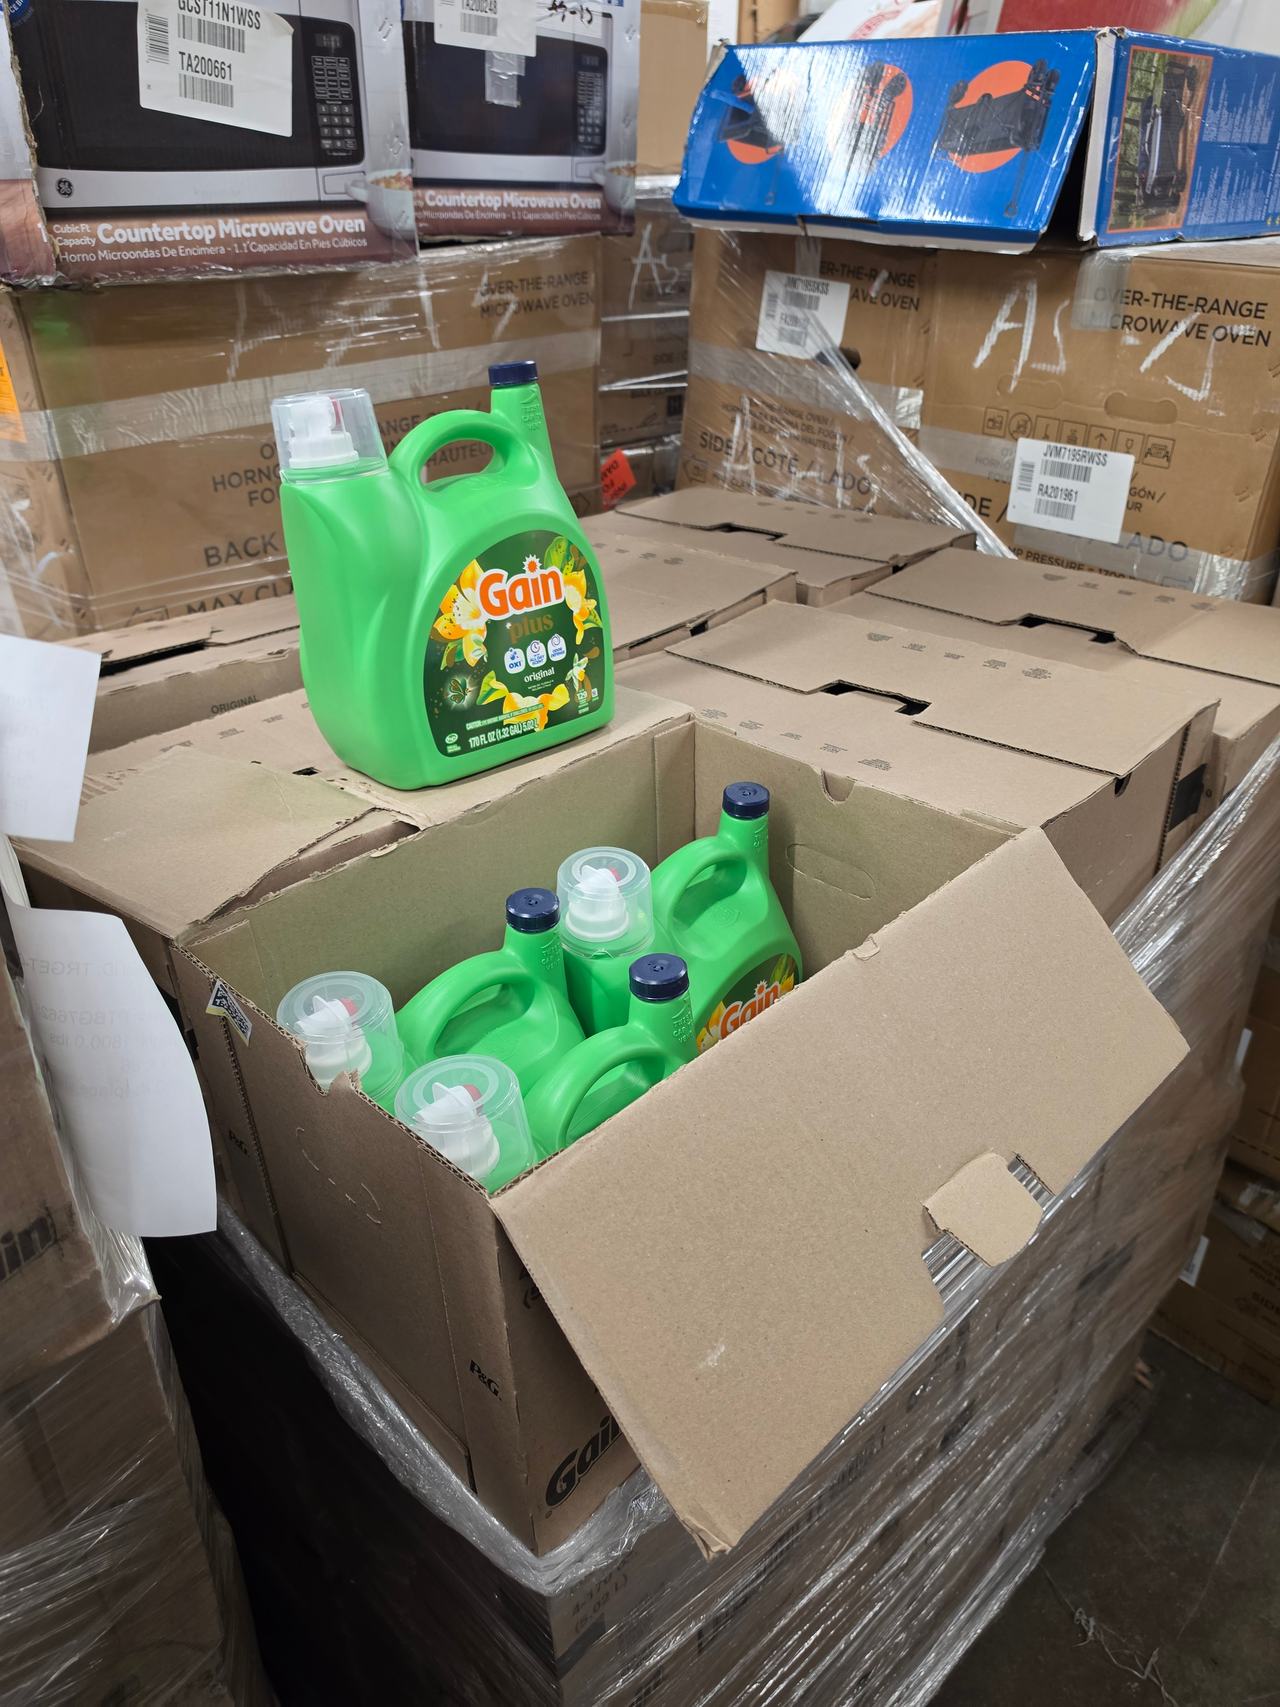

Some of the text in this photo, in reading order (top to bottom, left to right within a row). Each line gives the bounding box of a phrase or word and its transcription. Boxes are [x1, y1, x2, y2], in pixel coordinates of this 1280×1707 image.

[178, 0, 261, 30] GCST11N1WSS
[178, 51, 233, 81] TA200661
[426, 190, 601, 211] Countertop Microwave Oven
[56, 236, 96, 248] Capacity
[96, 214, 366, 245] Countertop Microwave Oven
[59, 251, 97, 263] Horno
[98, 247, 161, 261] Microondas
[162, 246, 178, 257] De
[179, 244, 226, 257] Encimera
[250, 239, 299, 254] Capacidad
[300, 239, 312, 250] En
[312, 238, 331, 249] Pies
[880, 292, 920, 312] OVEN
[1094, 287, 1268, 320] OVER-THE-RANGE
[1212, 324, 1272, 348] OVEN
[699, 431, 734, 456] SIDE
[1042, 443, 1108, 467] JVM7195RWSS
[1037, 482, 1079, 504] RA201961
[203, 531, 279, 568] BACK
[1115, 531, 1189, 562] ADO
[1025, 551, 1085, 572] PRESSURE
[477, 555, 565, 619] Gain
[509, 613, 555, 645] plus
[508, 660, 522, 669] OXI
[524, 666, 556, 683] original
[468, 735, 480, 749] 170
[480, 734, 488, 746] FL
[488, 731, 497, 743] OZ
[719, 979, 781, 1041] Gain
[469, 1359, 500, 1397] P&G
